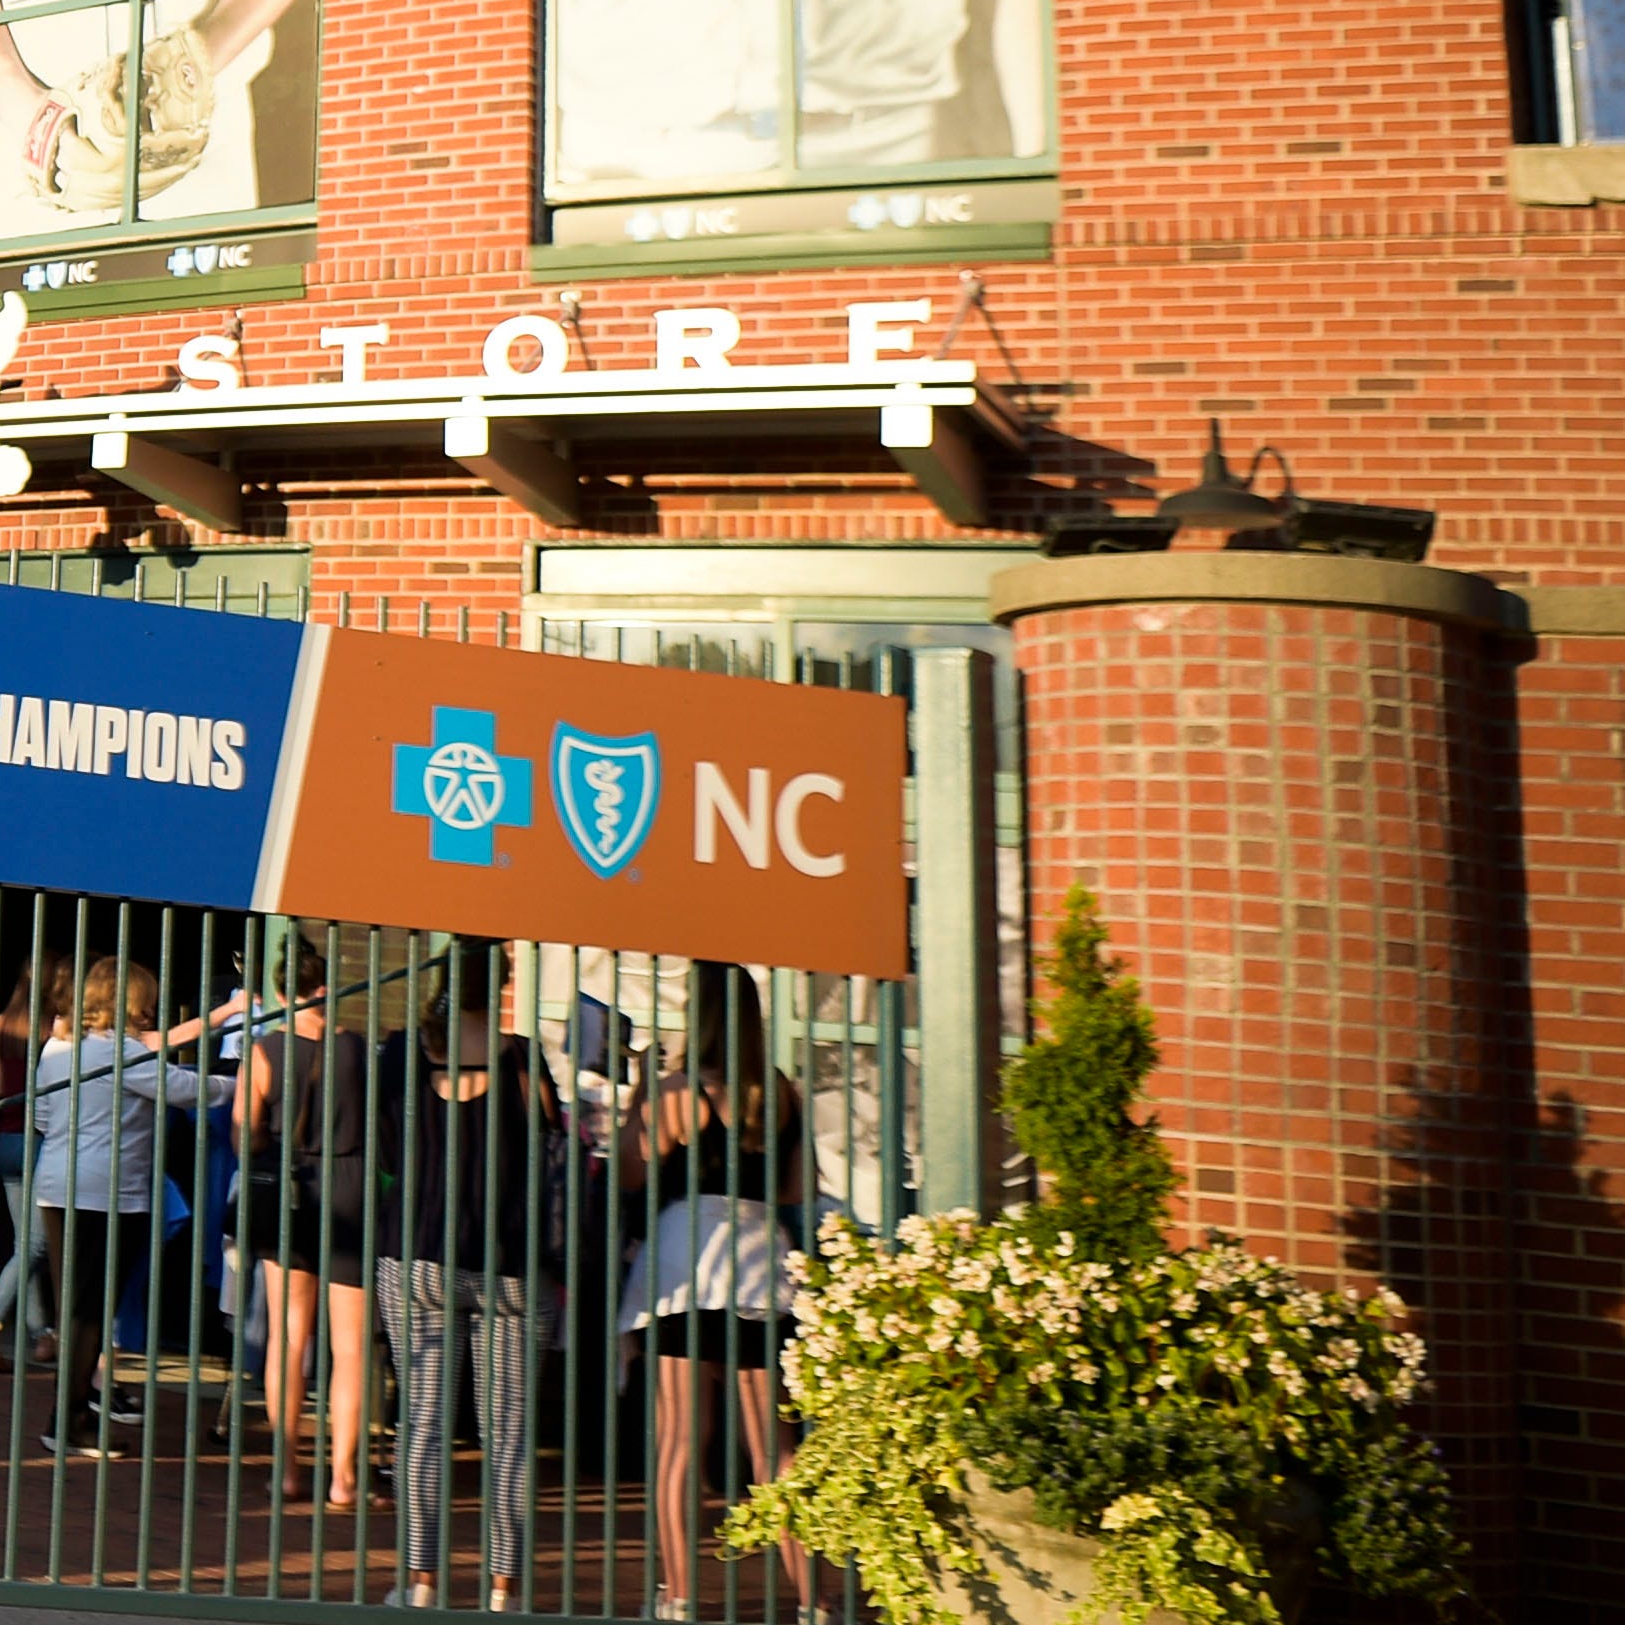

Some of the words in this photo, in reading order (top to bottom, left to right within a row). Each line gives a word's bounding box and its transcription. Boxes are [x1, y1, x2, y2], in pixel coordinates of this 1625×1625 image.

[67, 260, 99, 285] NC
[218, 243, 253, 269] NC
[177, 297, 935, 393] STORE
[693, 761, 846, 878] NC
